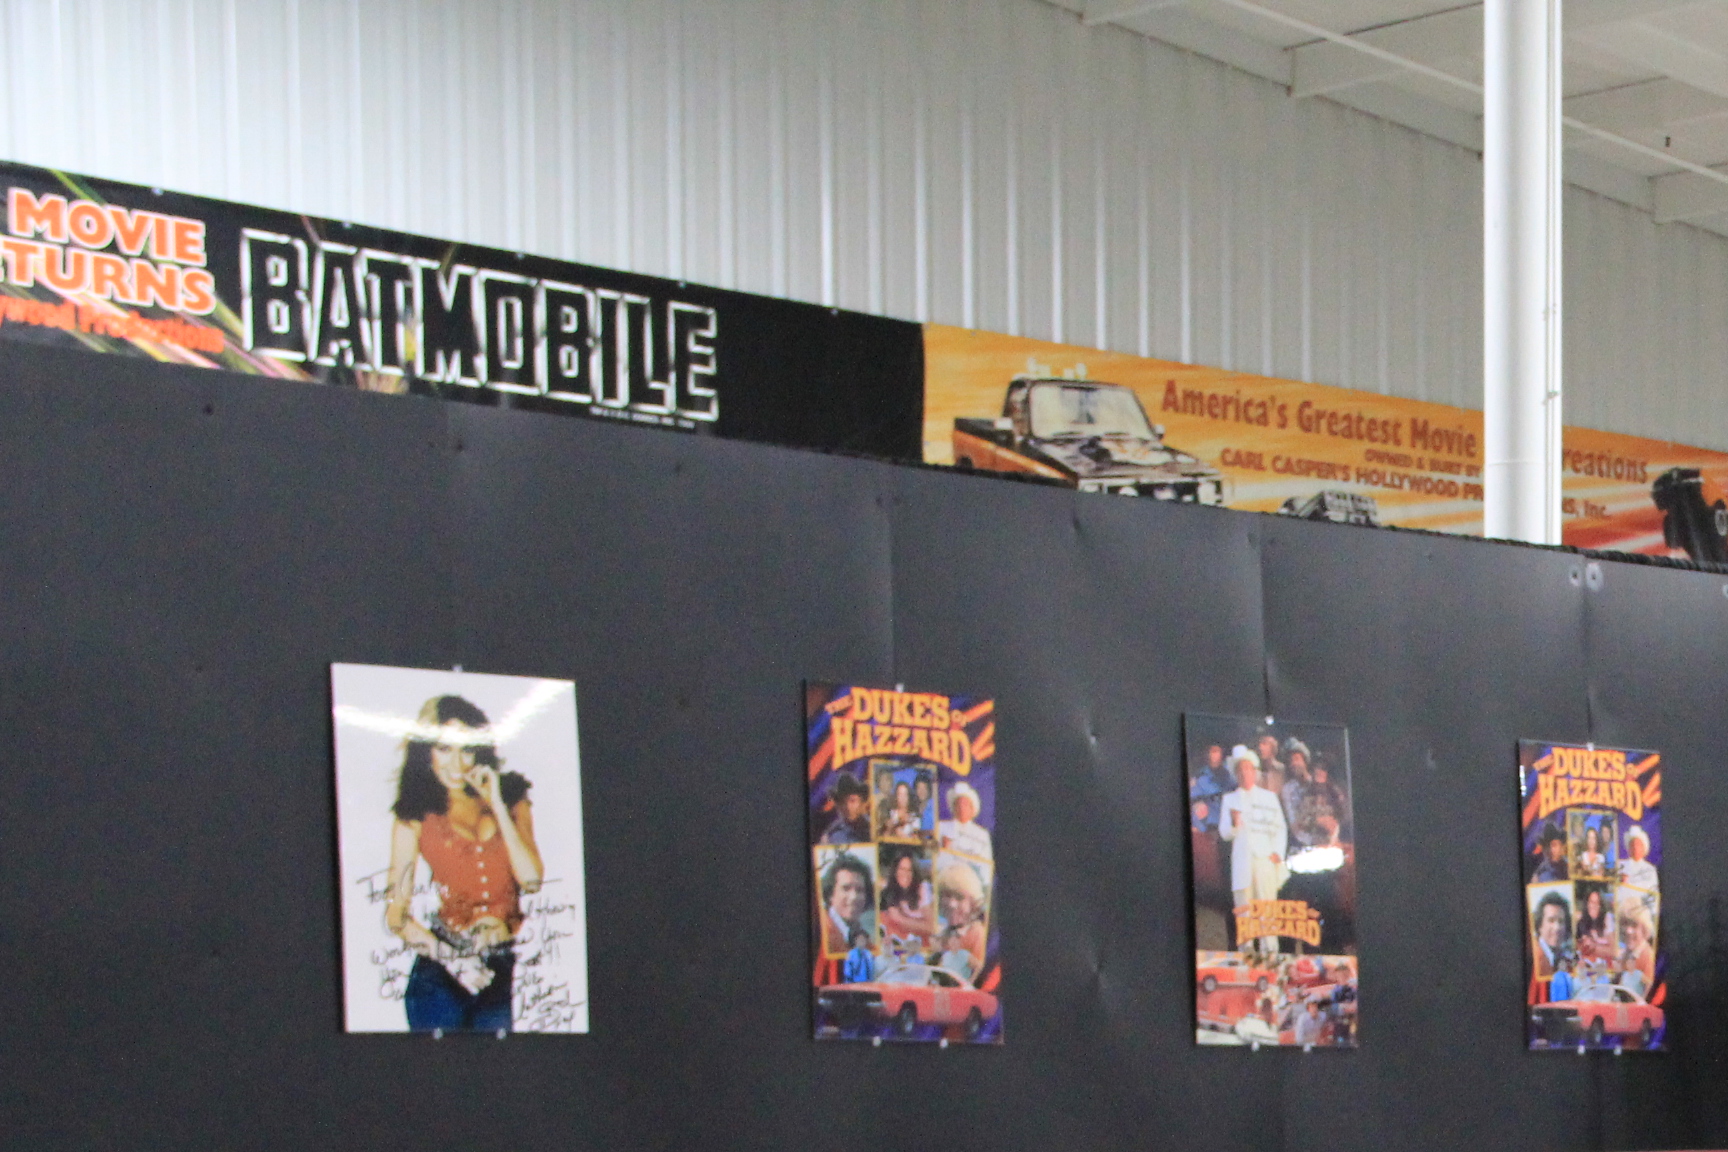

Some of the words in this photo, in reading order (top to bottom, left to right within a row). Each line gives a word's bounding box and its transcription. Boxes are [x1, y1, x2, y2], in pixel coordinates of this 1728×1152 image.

[9, 187, 206, 267] MOVIE
[0, 236, 217, 315] TURNS
[241, 228, 719, 423] BATMOBILE
[1161, 380, 1288, 429] America's
[1296, 400, 1402, 447] Greatest
[1410, 418, 1477, 458] Movie
[1562, 449, 1649, 484] reations
[1220, 447, 1266, 471] CARL
[1272, 455, 1351, 482] CASPER'S
[1356, 466, 1459, 498] HOLLYWOOD
[851, 686, 950, 730] DUKES
[831, 716, 972, 777] HAZZARD
[1552, 747, 1626, 782] DUKES
[1537, 773, 1643, 821] HAZZARD
